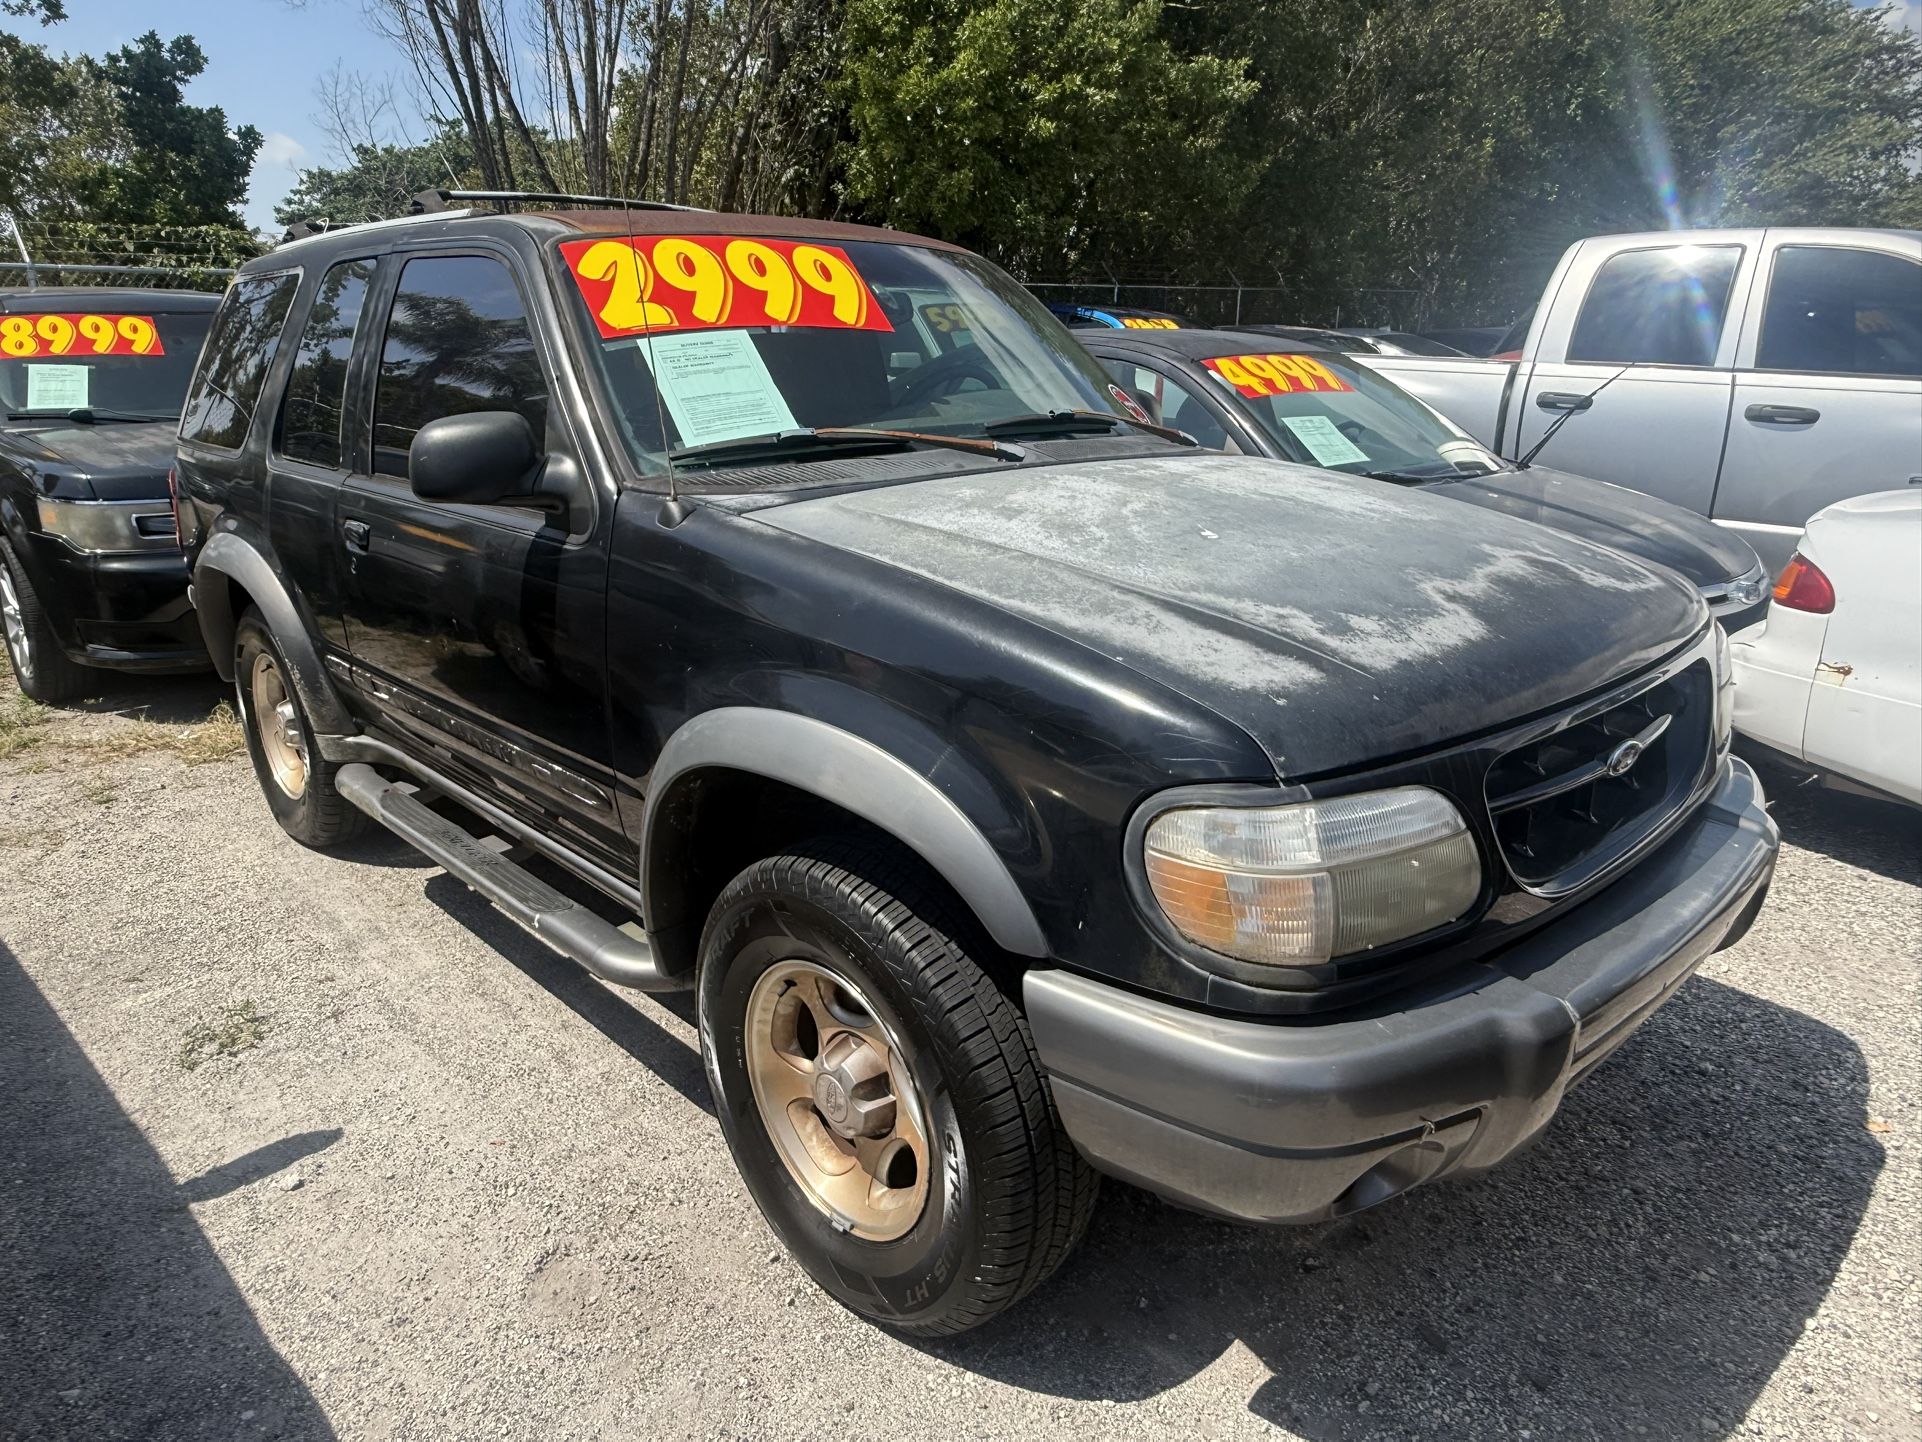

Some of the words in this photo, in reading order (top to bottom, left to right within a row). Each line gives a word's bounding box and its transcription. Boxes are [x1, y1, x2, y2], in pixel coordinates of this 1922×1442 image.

[577, 239, 867, 330] 2999
[0, 315, 158, 357] 8999
[1214, 355, 1344, 395] 4999
[934, 1131, 962, 1284] STRAUS
